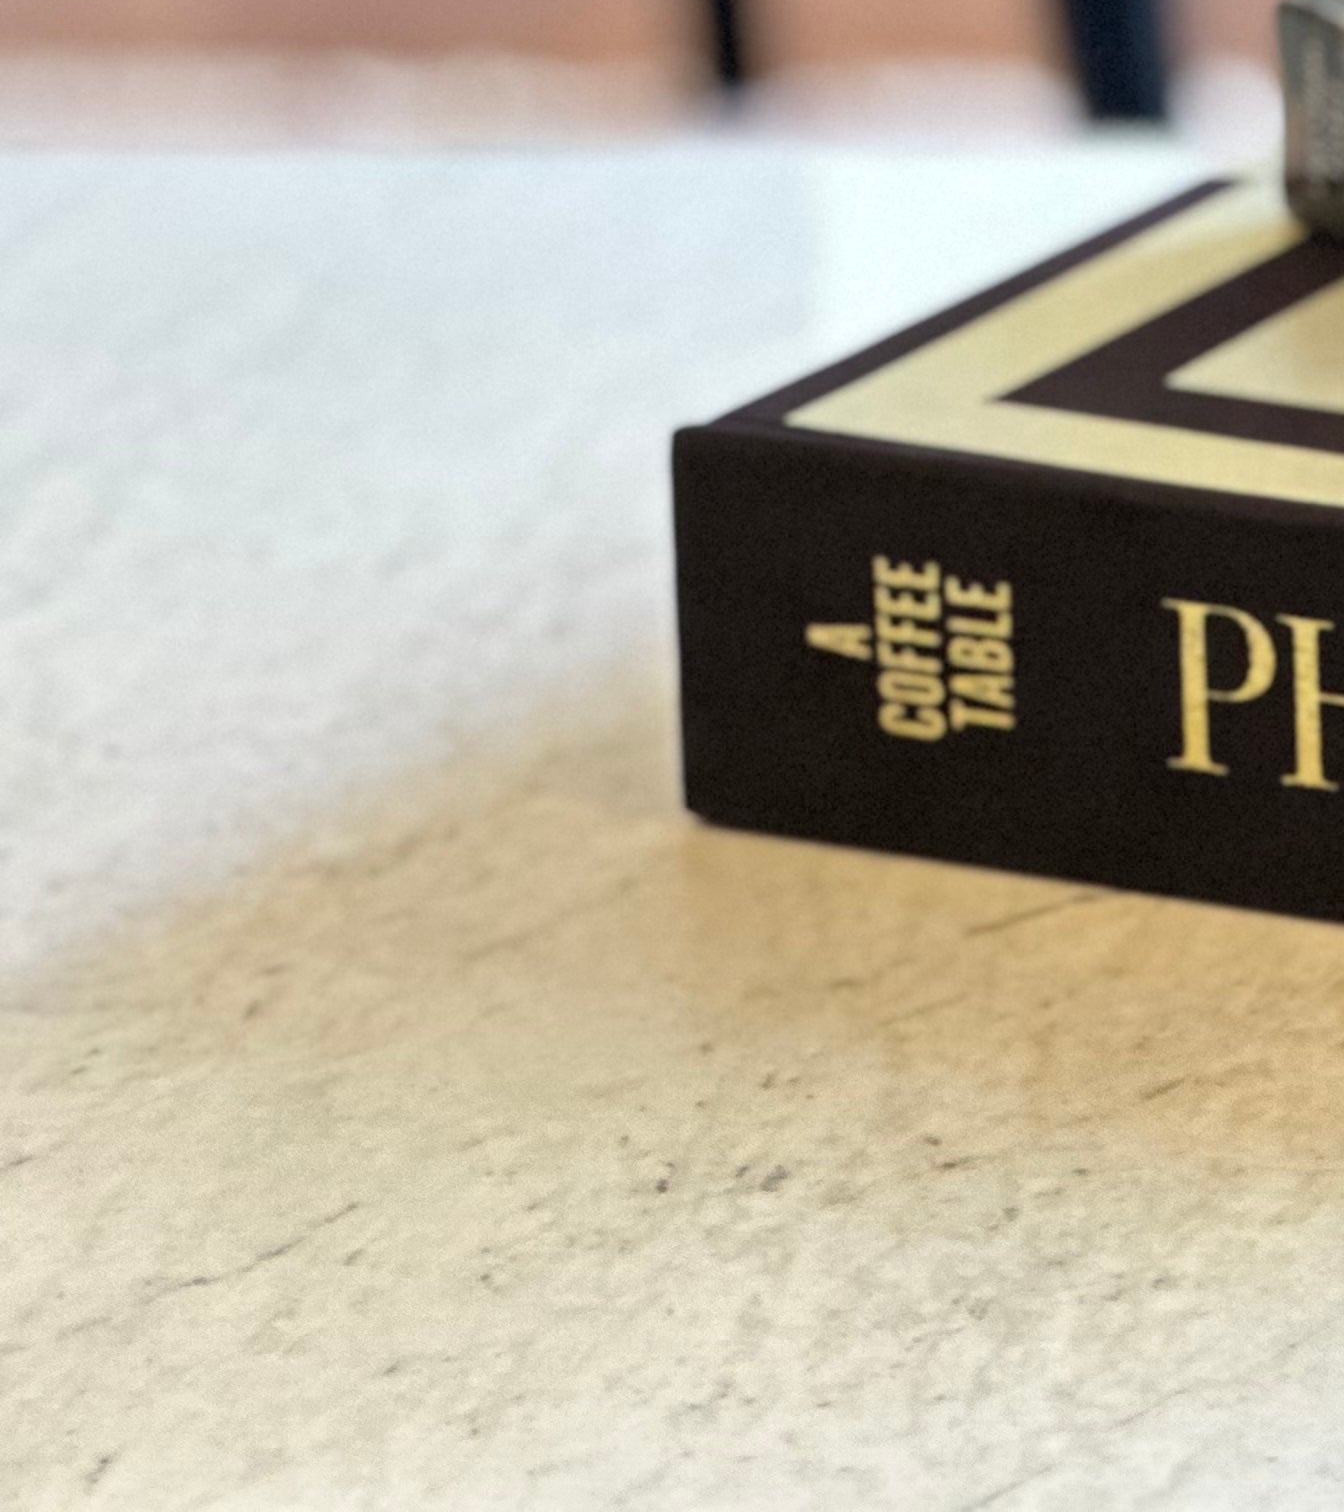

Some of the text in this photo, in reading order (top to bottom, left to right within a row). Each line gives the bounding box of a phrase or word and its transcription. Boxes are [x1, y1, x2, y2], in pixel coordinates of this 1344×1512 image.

[804, 620, 873, 662] A
[871, 553, 948, 742] COFFEE
[943, 573, 1017, 732] TABLE
